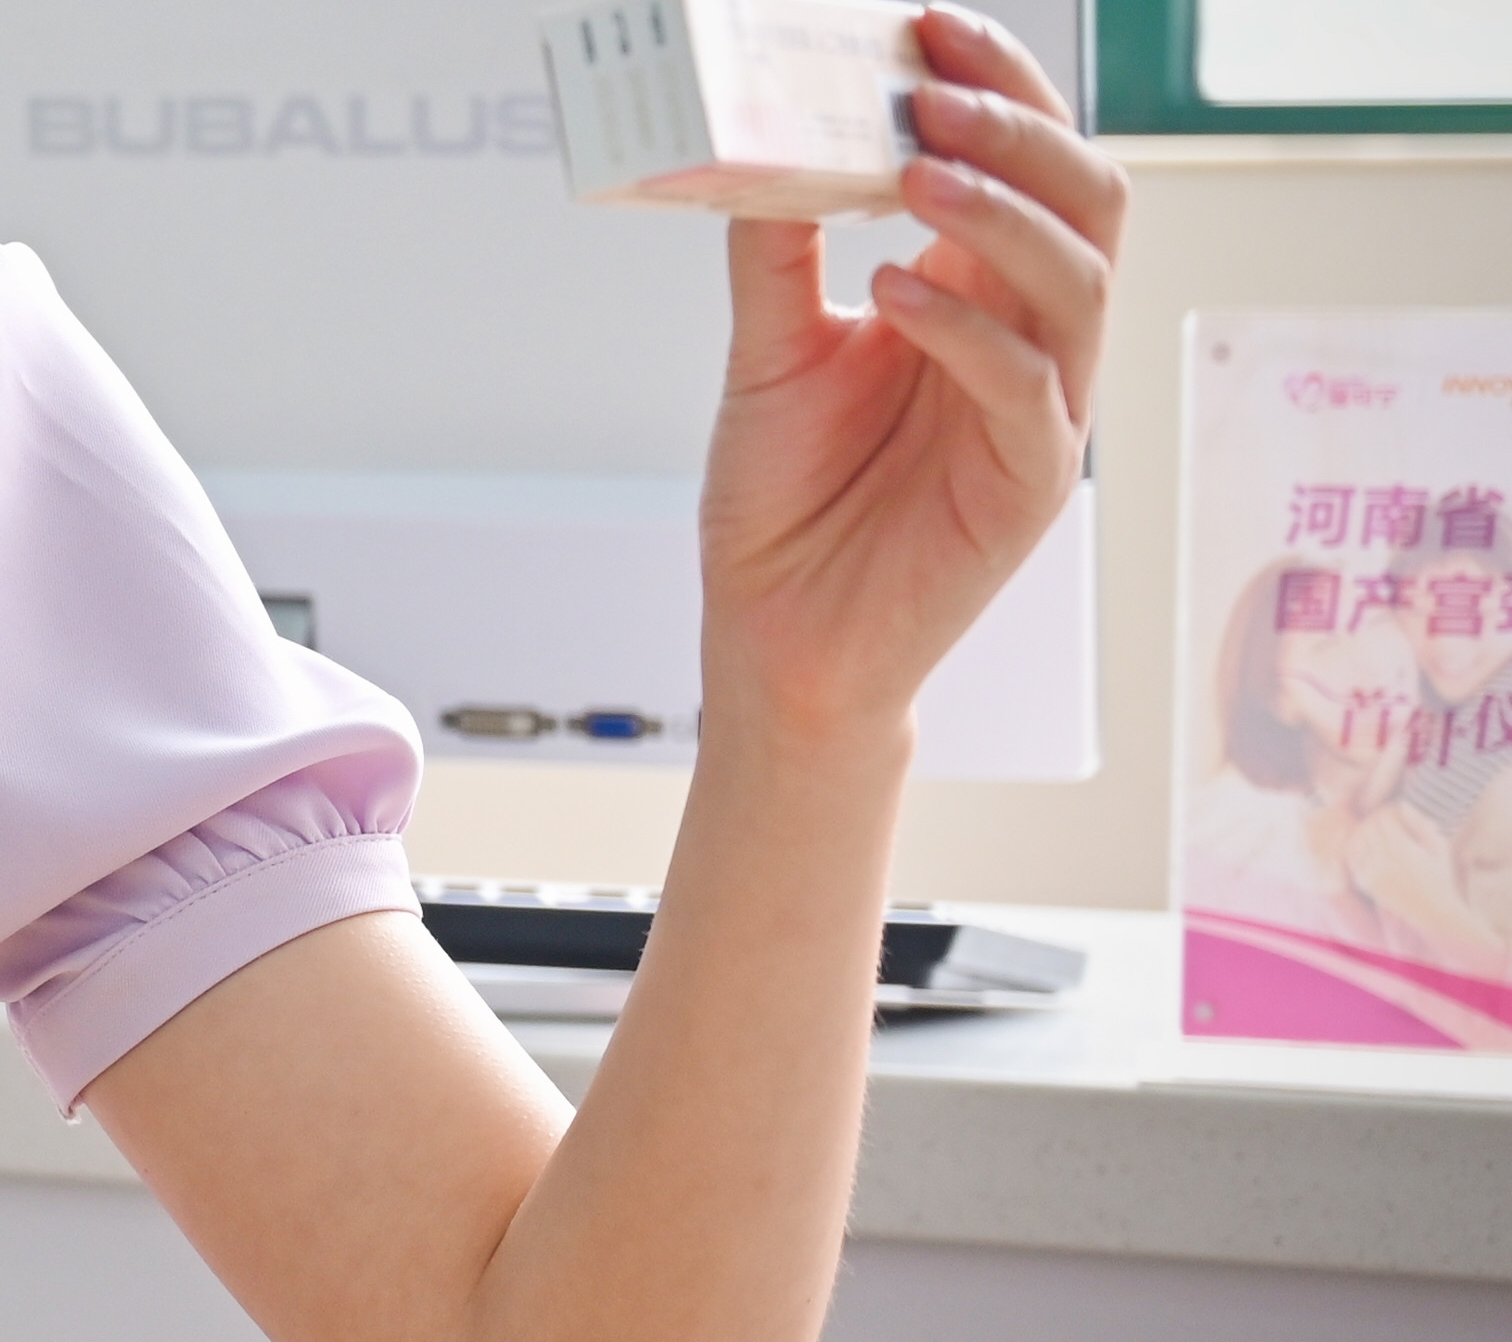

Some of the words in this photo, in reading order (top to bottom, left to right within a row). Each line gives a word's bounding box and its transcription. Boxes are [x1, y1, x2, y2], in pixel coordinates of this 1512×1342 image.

[26, 93, 561, 155] BUBALUS
[1285, 481, 1505, 549] 河南省
[1273, 567, 1512, 637] 国产宫
